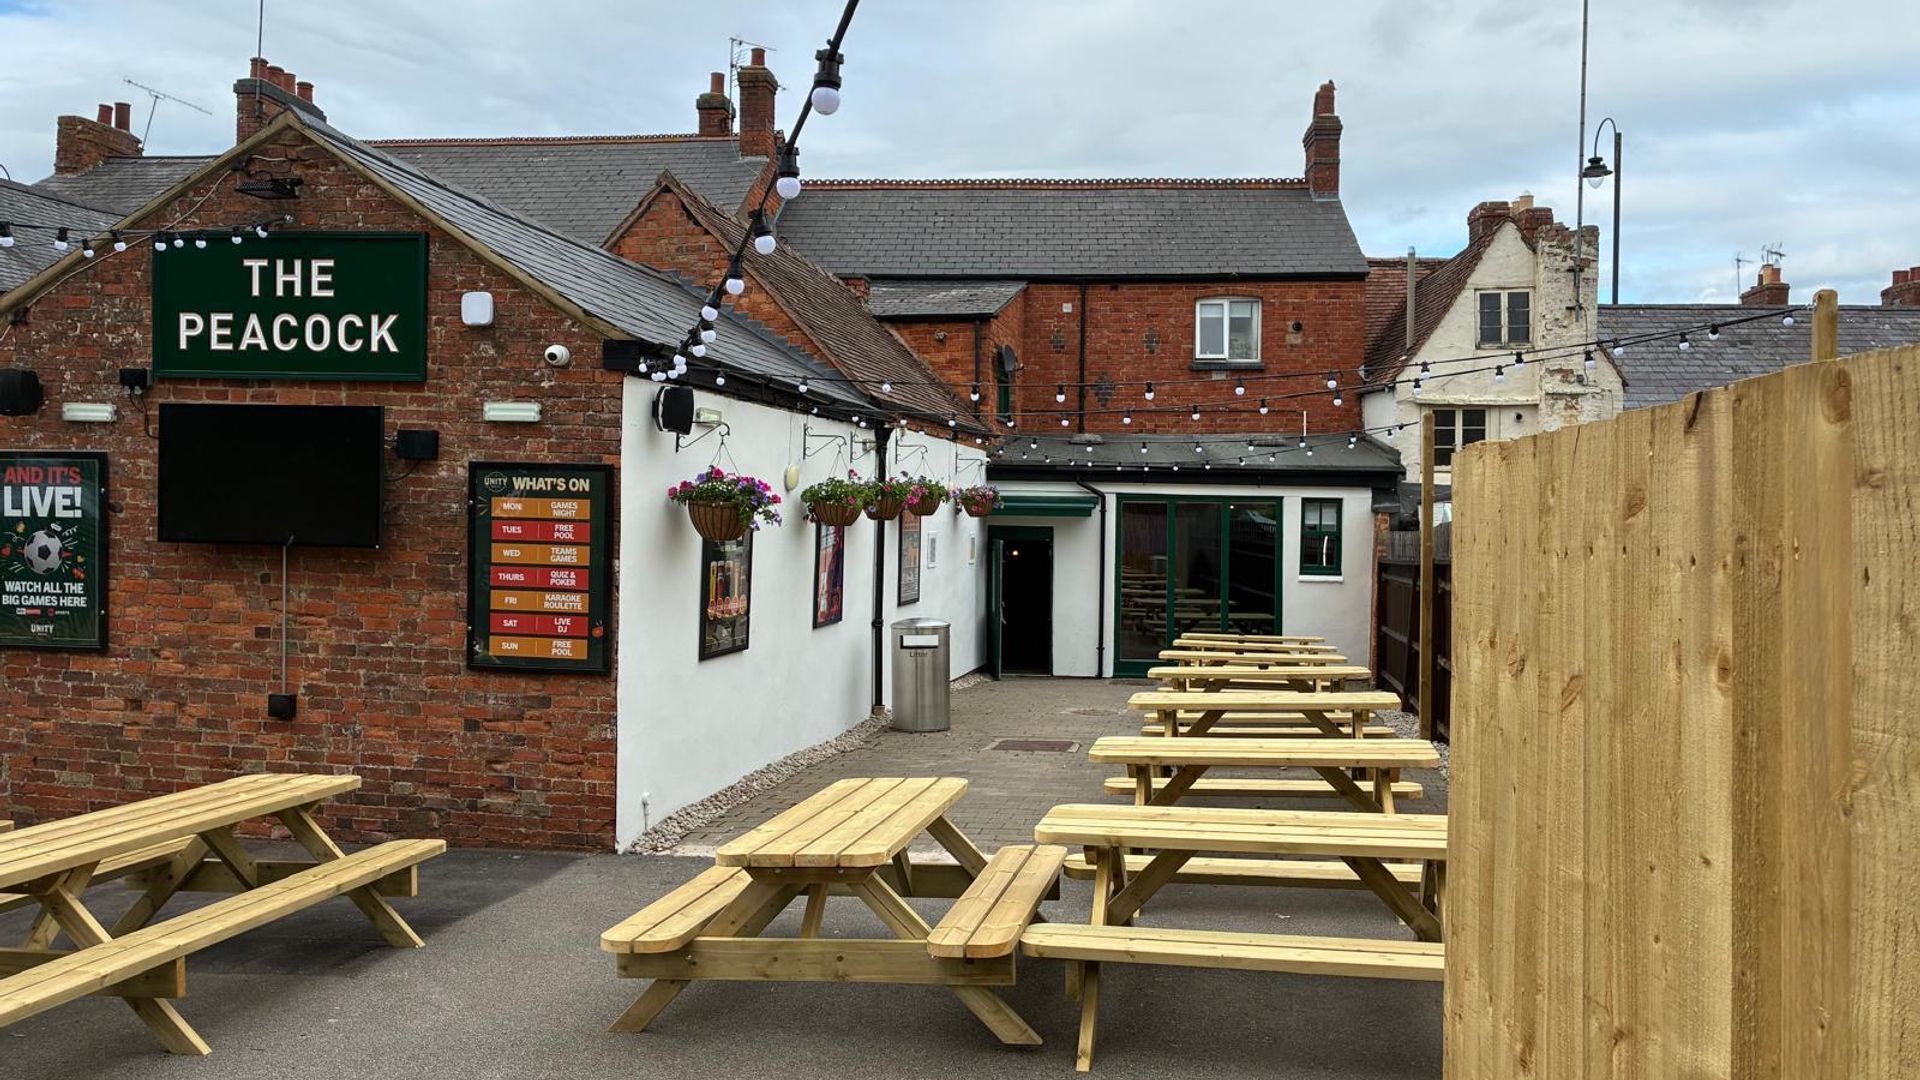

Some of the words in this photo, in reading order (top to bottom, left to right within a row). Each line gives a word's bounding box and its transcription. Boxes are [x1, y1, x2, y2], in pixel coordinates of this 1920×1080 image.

[243, 258, 335, 297] THE
[178, 312, 400, 353] PEACOCK
[4, 466, 44, 484] AND
[47, 466, 81, 485] IT'S
[484, 477, 508, 486] UNITY
[512, 477, 566, 491] WHAT'S
[568, 479, 590, 491] ON
[3, 485, 82, 518] LIVE!
[502, 503, 522, 511] MON
[552, 509, 576, 517] NIGHT
[502, 525, 522, 534] TUES
[554, 524, 574, 532] FREE
[554, 532, 575, 540] POOL
[503, 549, 521, 557] WED
[551, 547, 577, 555] TEAMS
[550, 555, 577, 563] GAMES
[498, 573, 525, 581] THURS
[550, 571, 569, 579] QUIZ
[569, 571, 576, 579] &
[4, 580, 41, 593] WATCH
[43, 581, 62, 594] ALL
[63, 582, 84, 594] THE
[550, 579, 576, 587] POKER
[2, 594, 20, 606] BIG
[21, 595, 58, 607] GAMES
[60, 596, 88, 608] HERE
[505, 596, 518, 605] FRI
[545, 594, 581, 602] KARAOKE
[543, 602, 583, 610] ROULETTE
[503, 619, 519, 628] SAT
[554, 618, 571, 626] LIVE
[31, 624, 54, 634] UNITY
[501, 642, 518, 650] SUN
[552, 640, 572, 649] FREE
[551, 648, 573, 656] POOL
